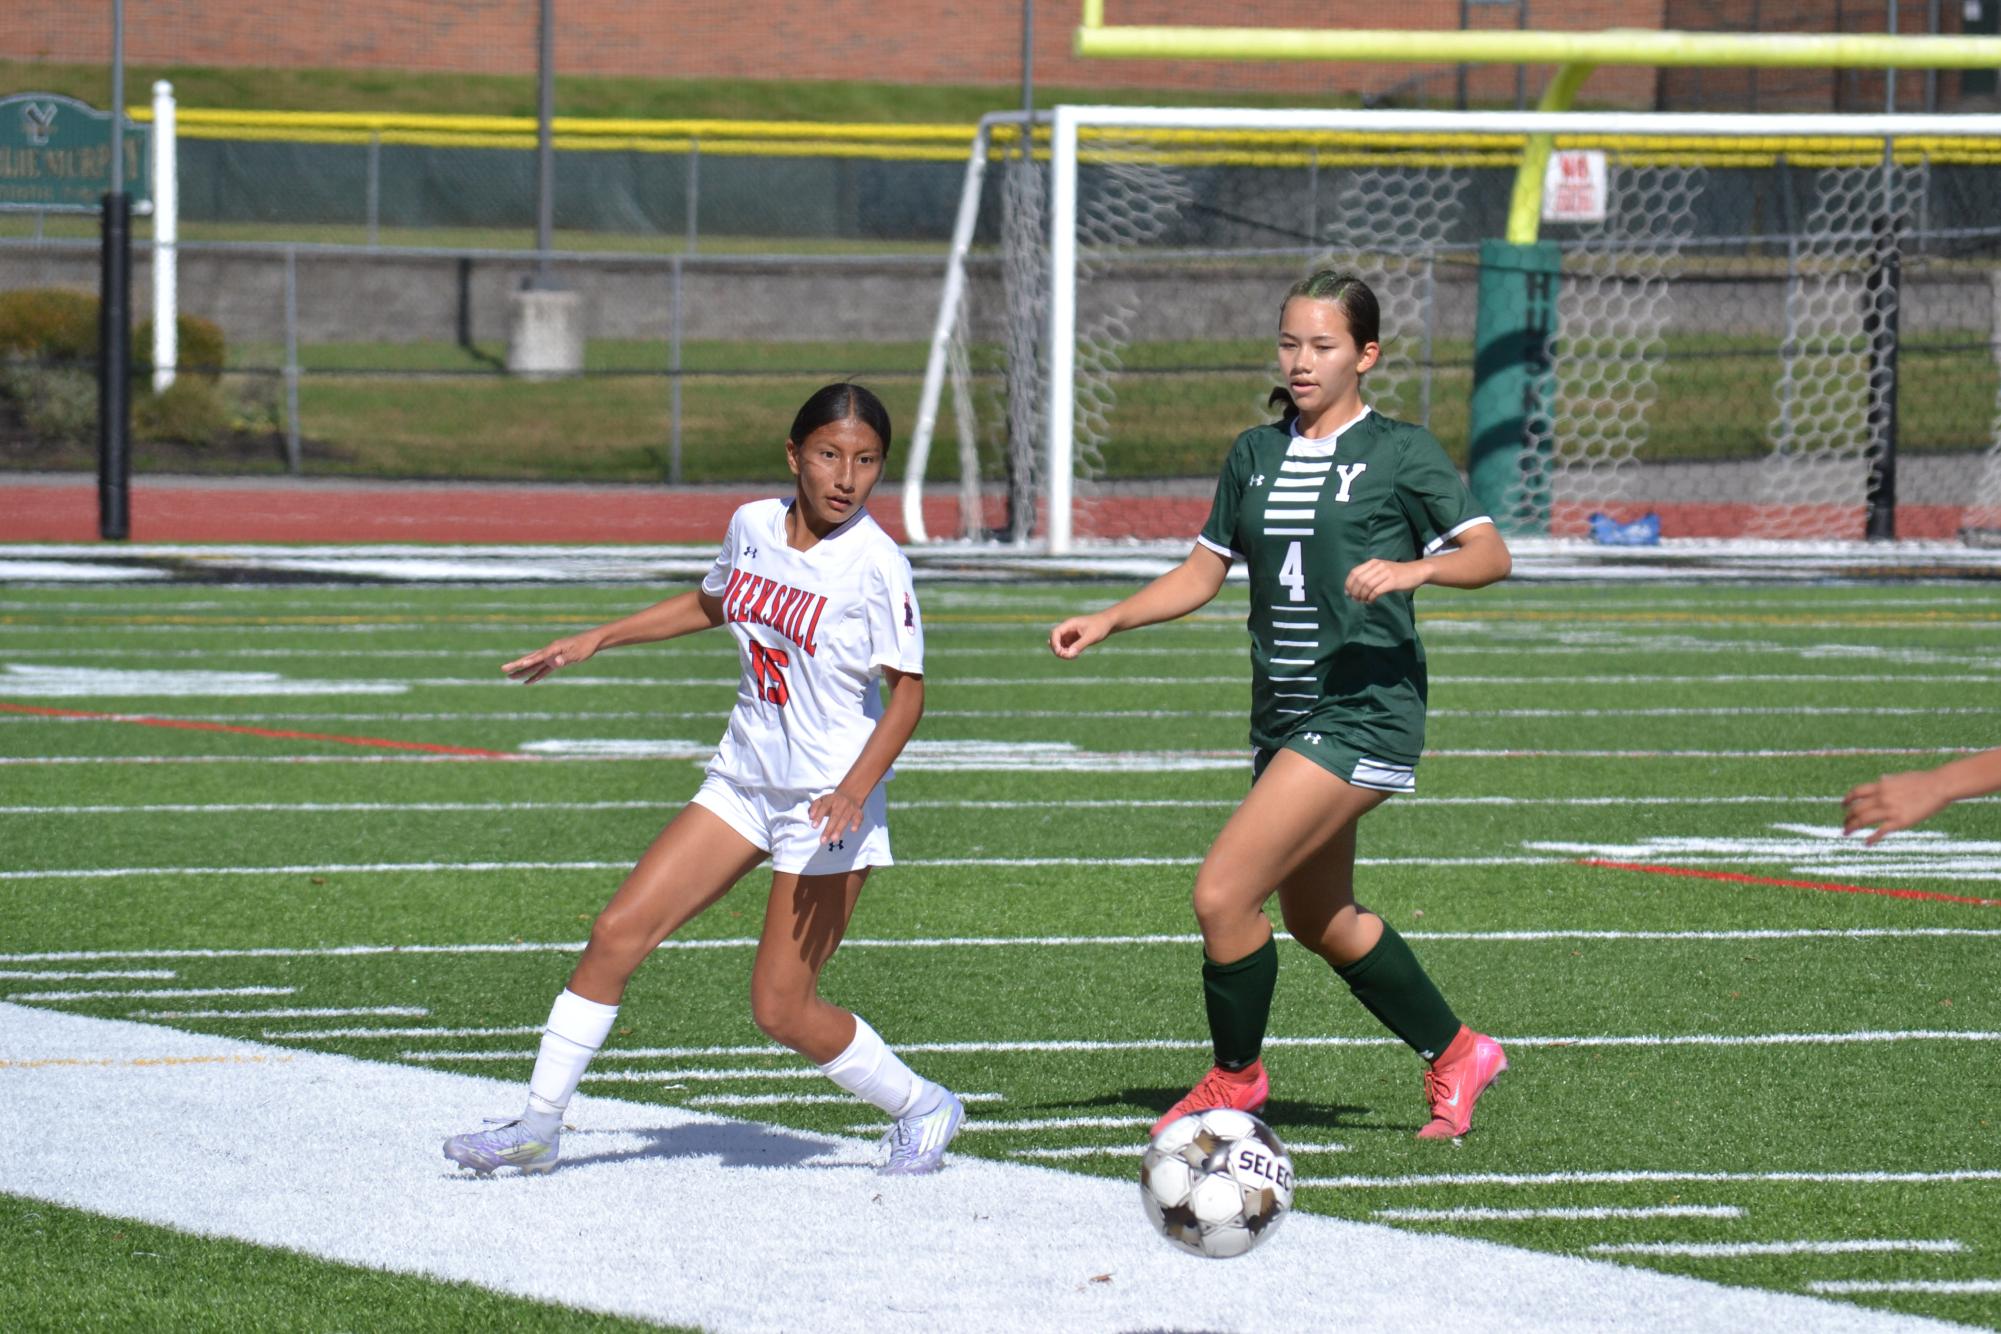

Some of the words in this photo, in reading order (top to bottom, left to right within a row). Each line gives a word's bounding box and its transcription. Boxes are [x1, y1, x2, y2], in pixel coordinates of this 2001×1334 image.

[1335, 463, 1367, 502] Y
[1278, 541, 1306, 602] 4
[749, 639, 789, 708] 15
